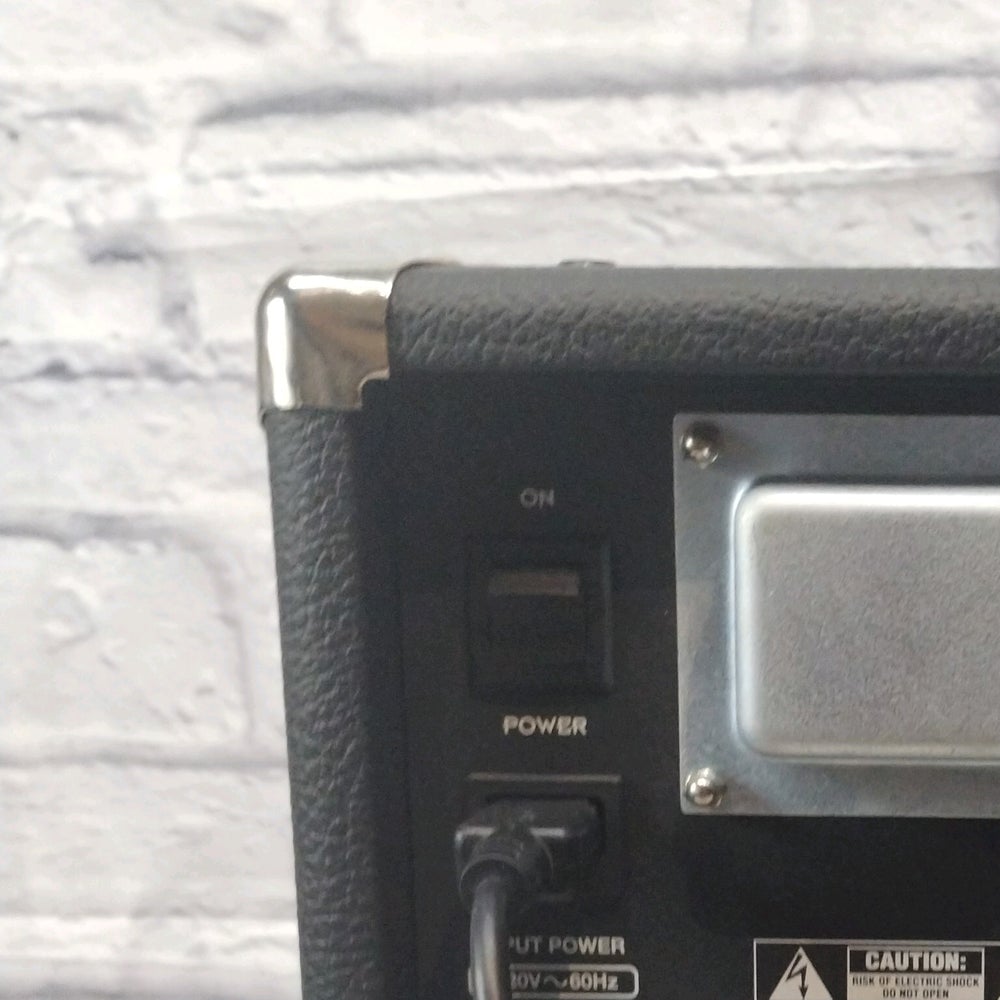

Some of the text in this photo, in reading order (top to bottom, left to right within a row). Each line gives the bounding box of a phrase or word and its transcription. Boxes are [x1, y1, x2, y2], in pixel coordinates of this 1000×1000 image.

[519, 487, 555, 508] ON
[502, 715, 588, 736] POWER
[548, 935, 626, 956] POWER
[865, 950, 967, 972] CAUTION:
[852, 976, 980, 987] RISK OF ELECTRIC SHOCK
[882, 989, 949, 999] DO NOT OPEN
